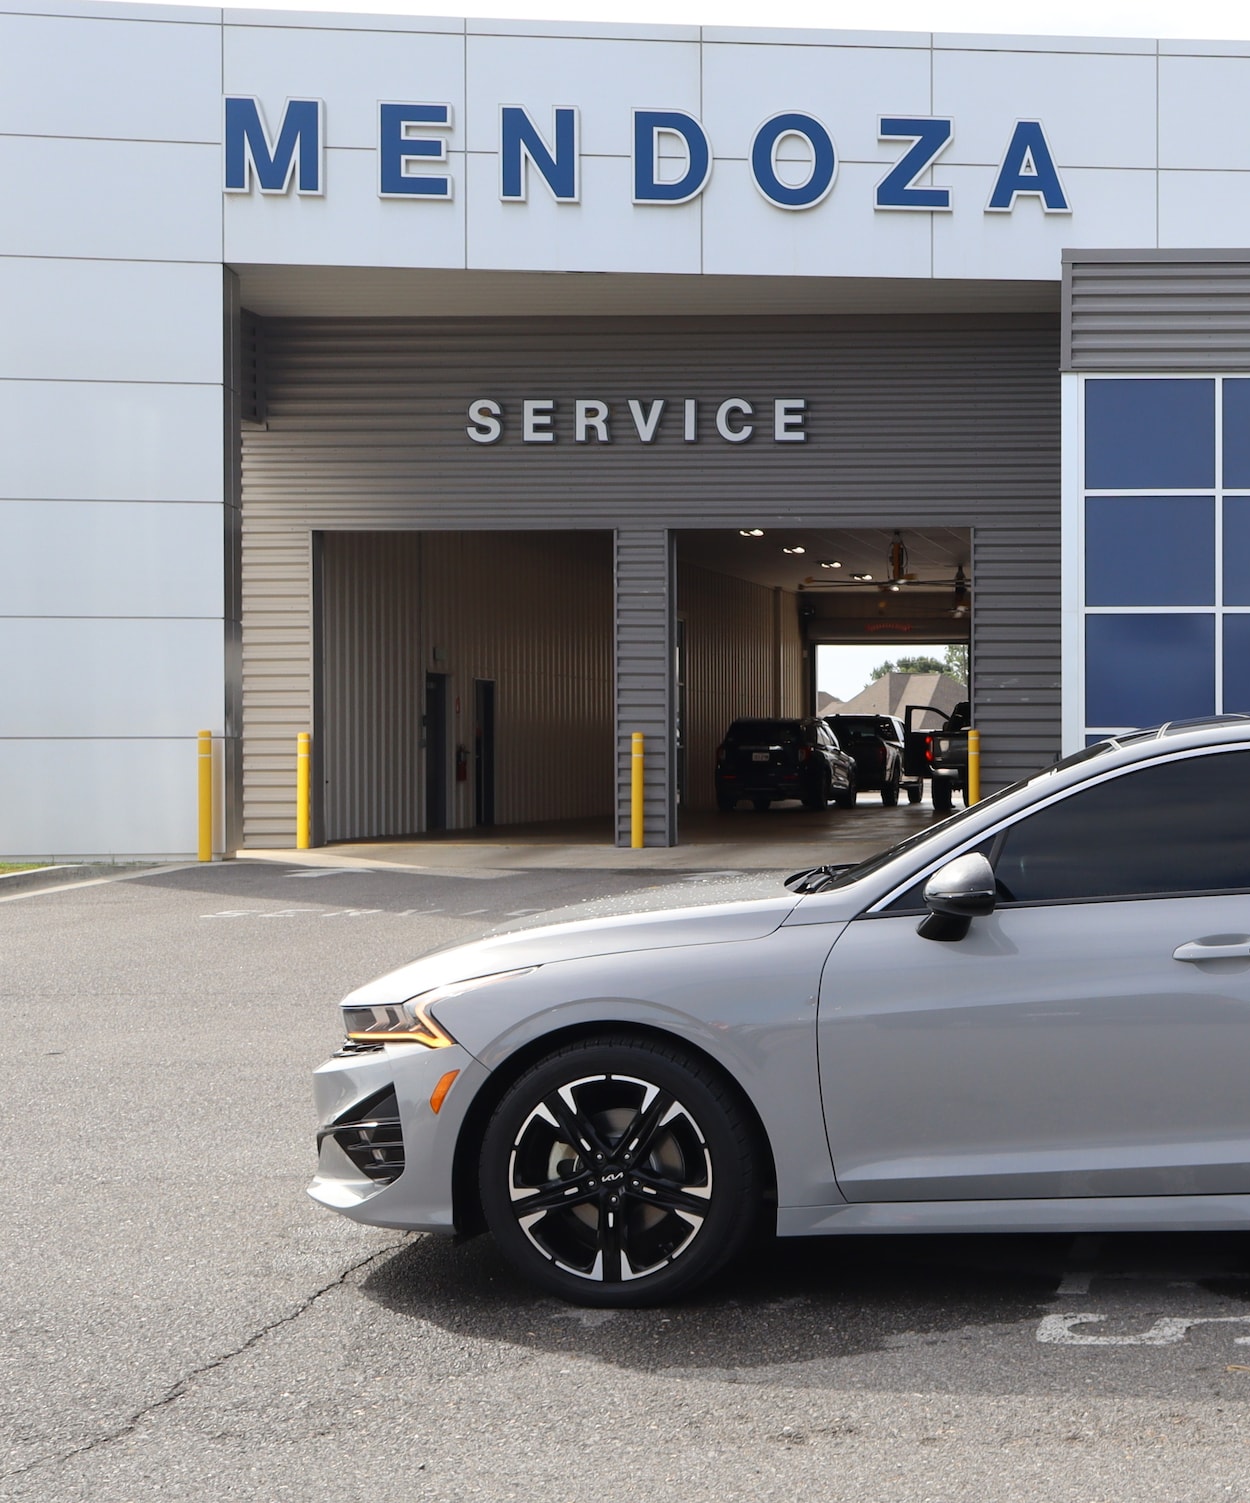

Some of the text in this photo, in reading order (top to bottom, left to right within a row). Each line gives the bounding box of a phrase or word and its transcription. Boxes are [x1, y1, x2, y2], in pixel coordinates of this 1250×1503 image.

[222, 94, 1073, 214] MENDOZA
[466, 398, 810, 446] SERVICE
[199, 908, 546, 918] SERVIC
